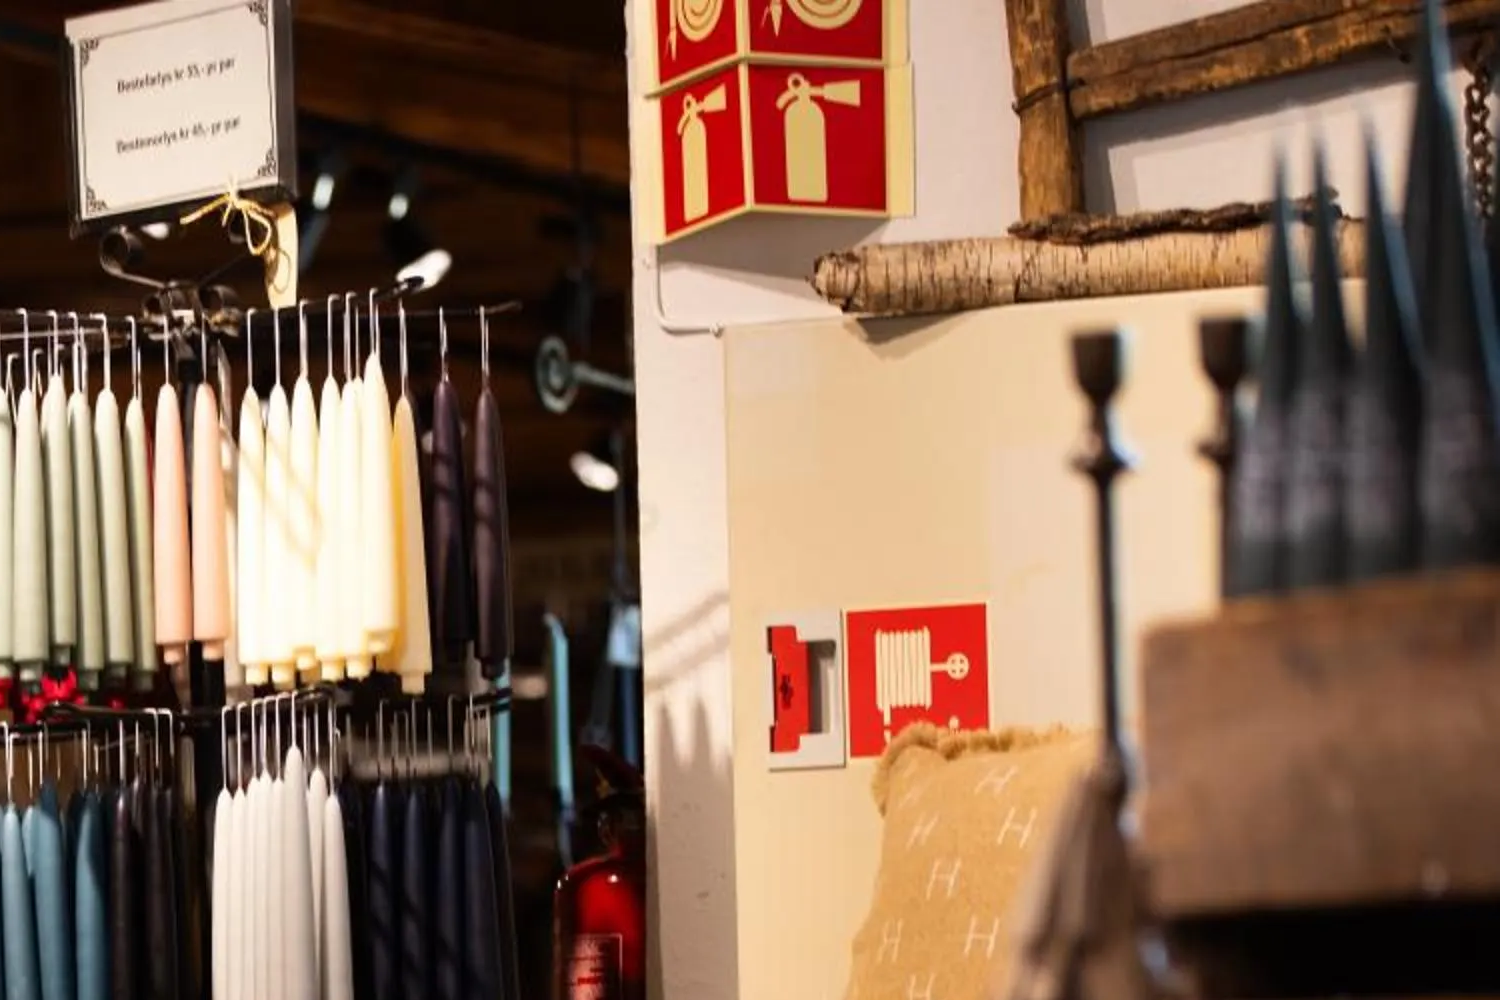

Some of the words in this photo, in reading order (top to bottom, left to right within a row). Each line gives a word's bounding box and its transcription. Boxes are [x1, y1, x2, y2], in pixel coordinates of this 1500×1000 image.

[997, 807, 1038, 848] H
[926, 857, 961, 900] H
[964, 916, 999, 960] H
